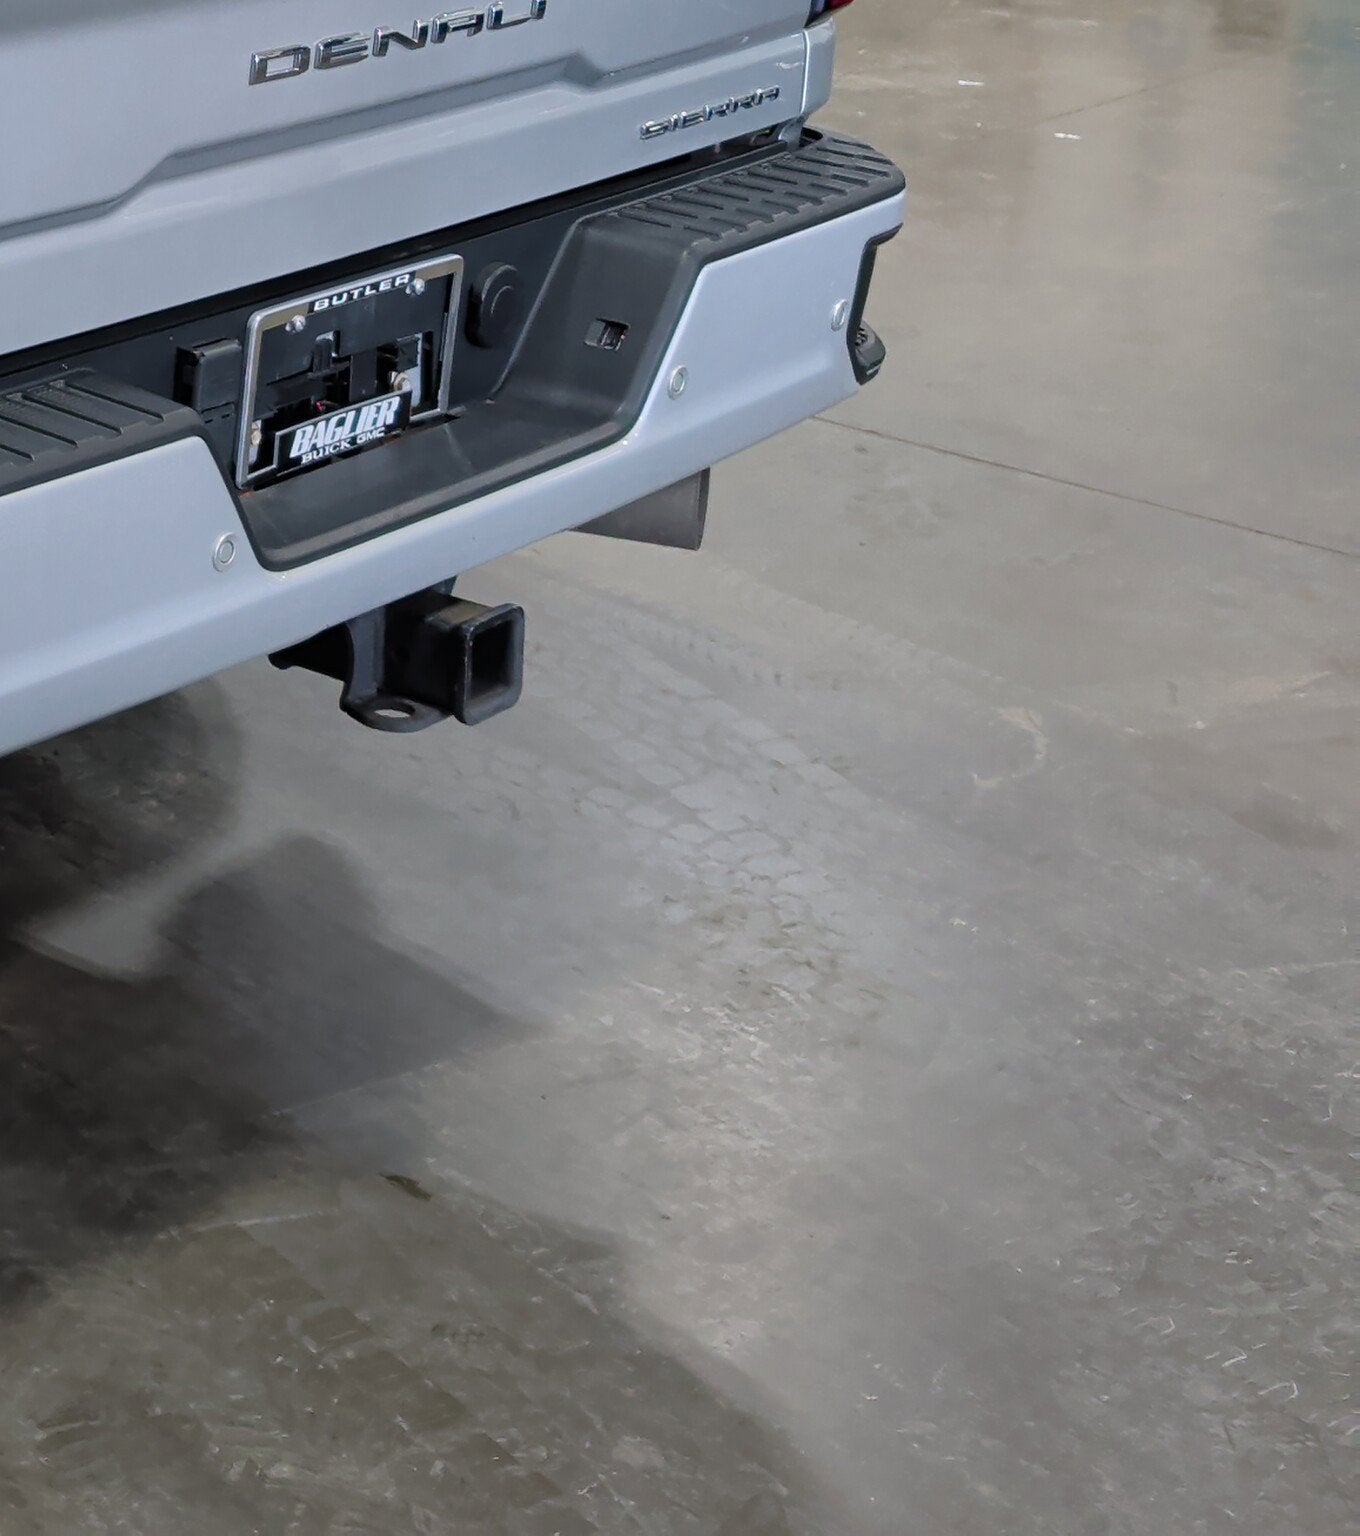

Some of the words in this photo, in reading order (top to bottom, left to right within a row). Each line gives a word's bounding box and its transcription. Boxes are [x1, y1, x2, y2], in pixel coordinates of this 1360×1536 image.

[639, 85, 780, 140] SIERRA
[313, 273, 411, 311] BUTLER
[290, 396, 400, 458] BAGLIER
[301, 438, 351, 464] BUICK
[356, 426, 386, 443] GMC
